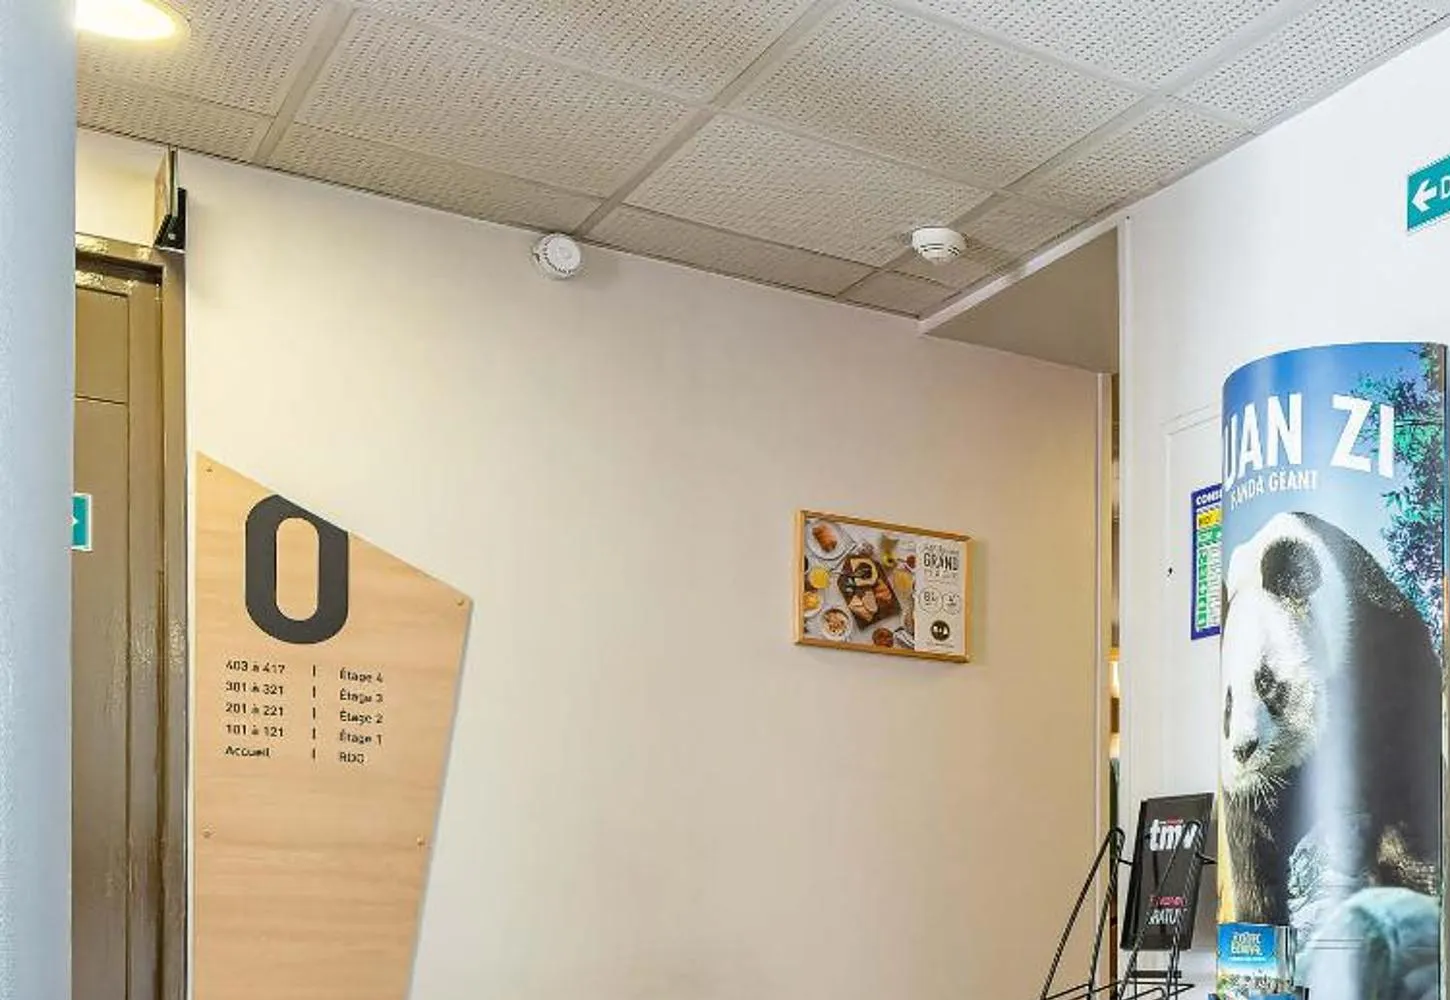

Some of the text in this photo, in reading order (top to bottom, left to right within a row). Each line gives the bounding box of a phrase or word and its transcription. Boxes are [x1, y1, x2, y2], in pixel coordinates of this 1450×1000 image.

[1330, 393, 1395, 479] ZI
[1269, 470, 1318, 492] GÉANT
[225, 661, 248, 672] 403
[263, 662, 285, 674] 417
[339, 667, 372, 683] Étage
[225, 682, 246, 692] 301
[263, 684, 284, 695] 321
[339, 688, 372, 704] Étage
[225, 703, 246, 713] 201
[263, 705, 284, 716] 221
[339, 708, 372, 724] Étage
[226, 724, 247, 735] 101
[263, 726, 284, 737] 121
[339, 729, 372, 744] Étage
[225, 745, 365, 763] Accueil RDC
